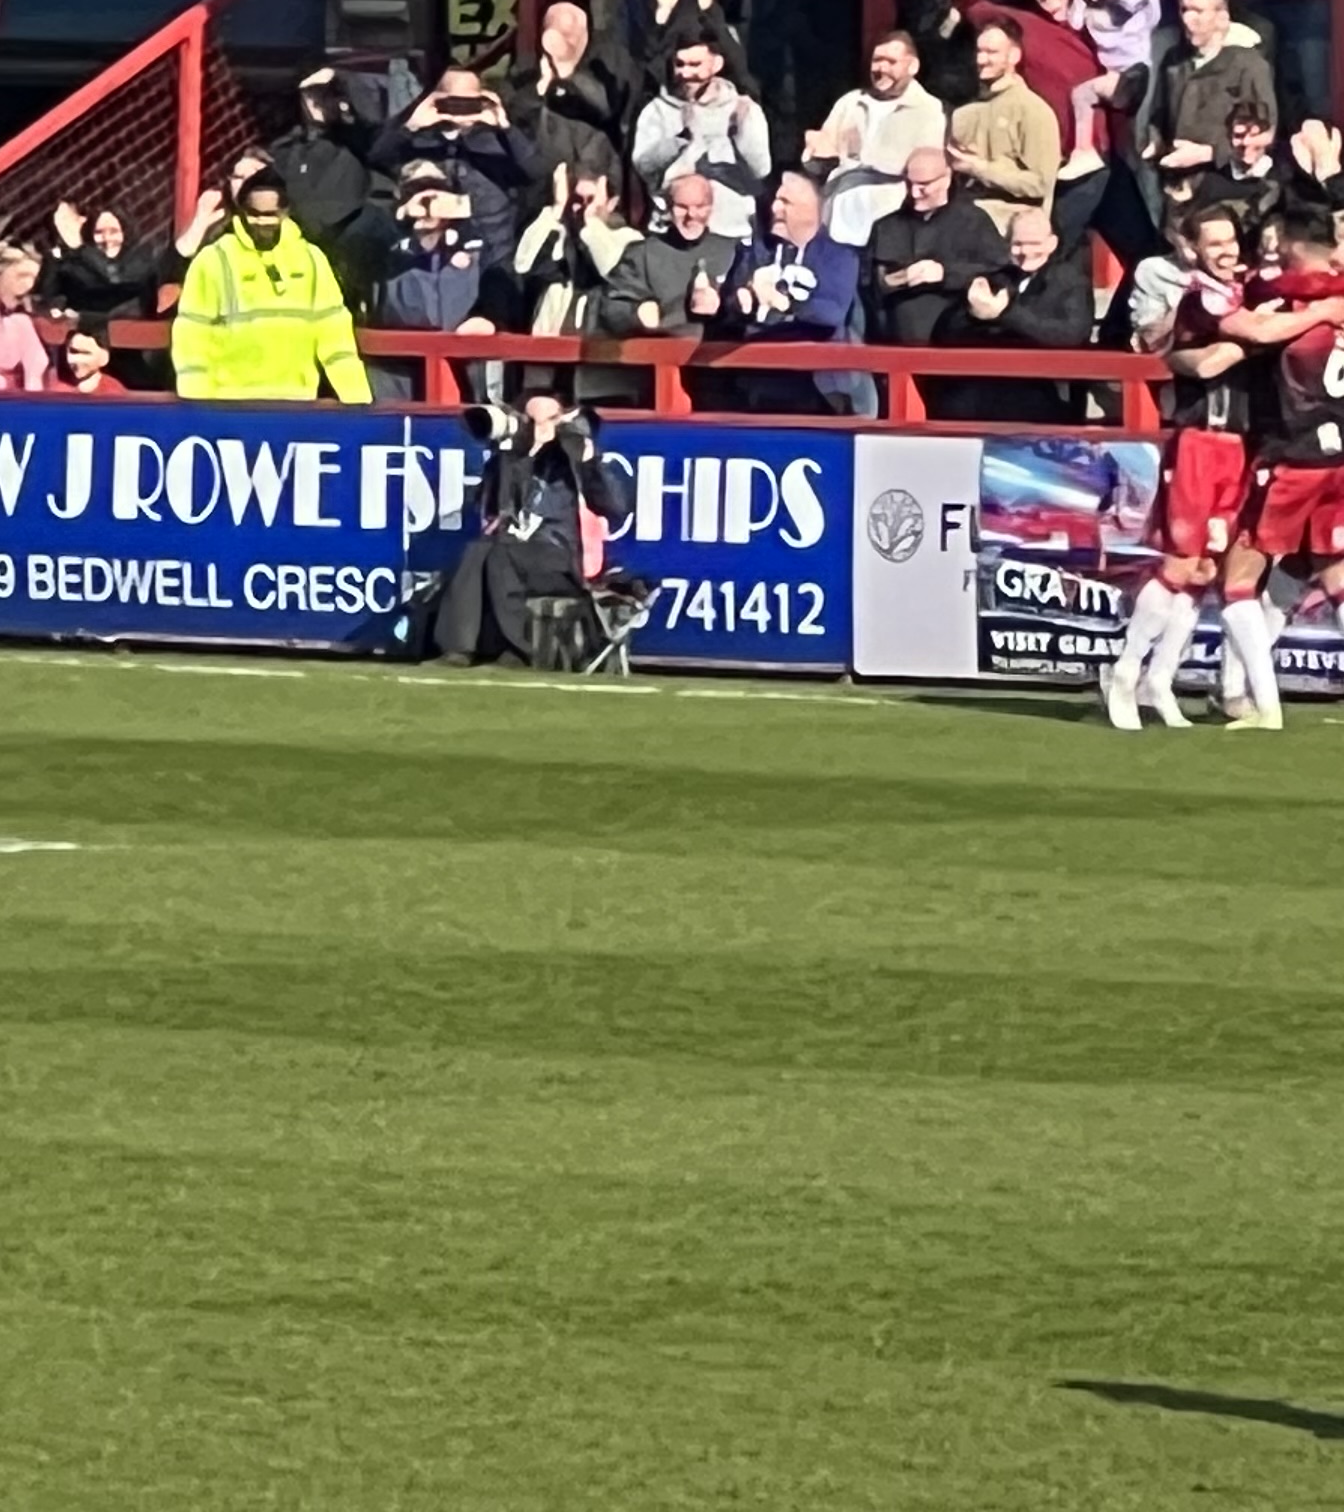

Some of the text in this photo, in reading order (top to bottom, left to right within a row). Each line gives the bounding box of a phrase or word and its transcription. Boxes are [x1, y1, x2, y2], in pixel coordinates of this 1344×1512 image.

[46, 433, 95, 520] J
[112, 434, 342, 528] ROWE
[359, 444, 492, 534] FSH
[27, 553, 234, 609] BEDWELL
[243, 563, 414, 614] CRESC
[661, 577, 826, 636] 741412
[1058, 635, 1125, 657] GRAV
